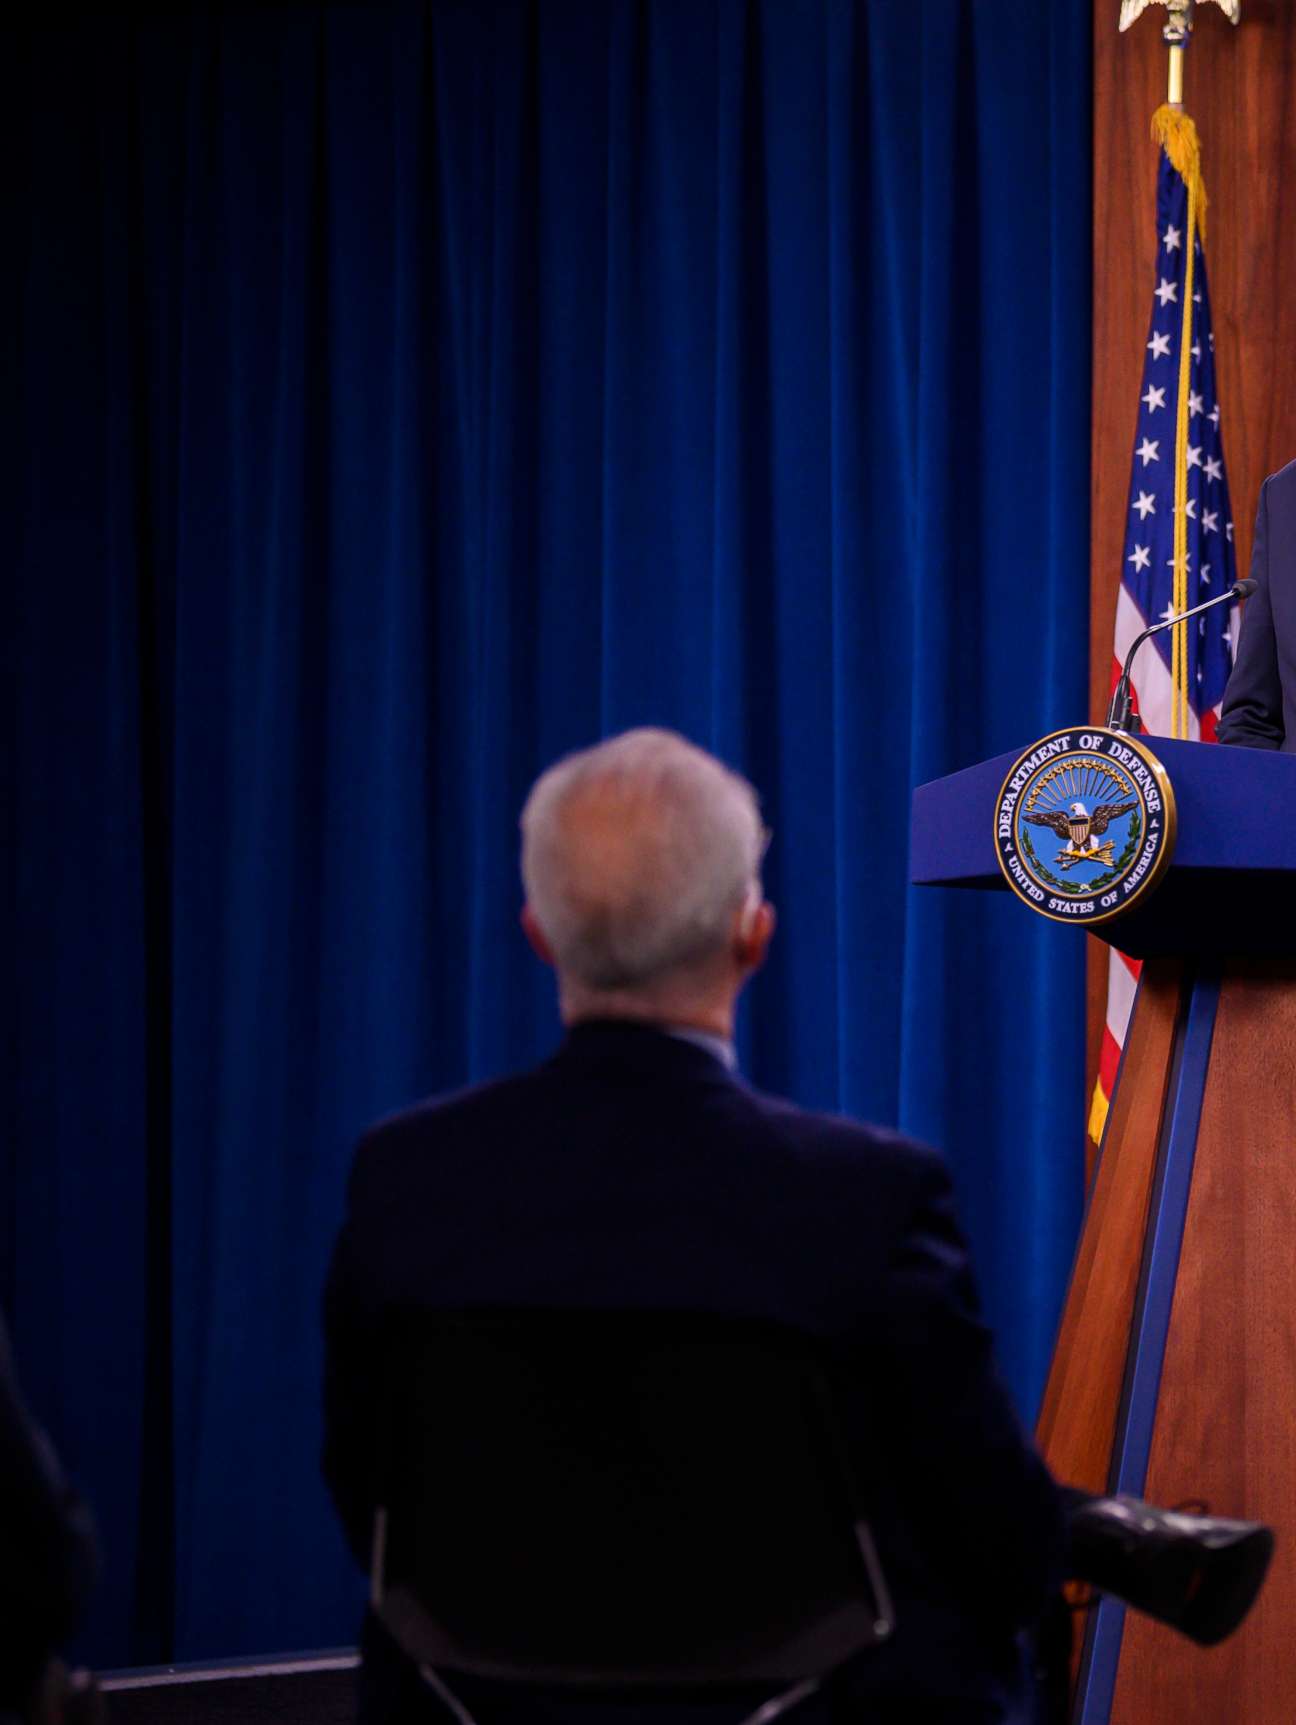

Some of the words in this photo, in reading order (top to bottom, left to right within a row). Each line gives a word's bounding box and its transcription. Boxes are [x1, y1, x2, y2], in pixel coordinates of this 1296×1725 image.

[999, 736, 1071, 838] DEPARTMENT
[1079, 734, 1104, 750] OF
[1109, 742, 1160, 813] DEFENSE
[1008, 855, 1045, 902] UNITED
[1048, 897, 1095, 914] STATES
[1100, 891, 1118, 908] OF
[1124, 833, 1158, 893] AMERICA
